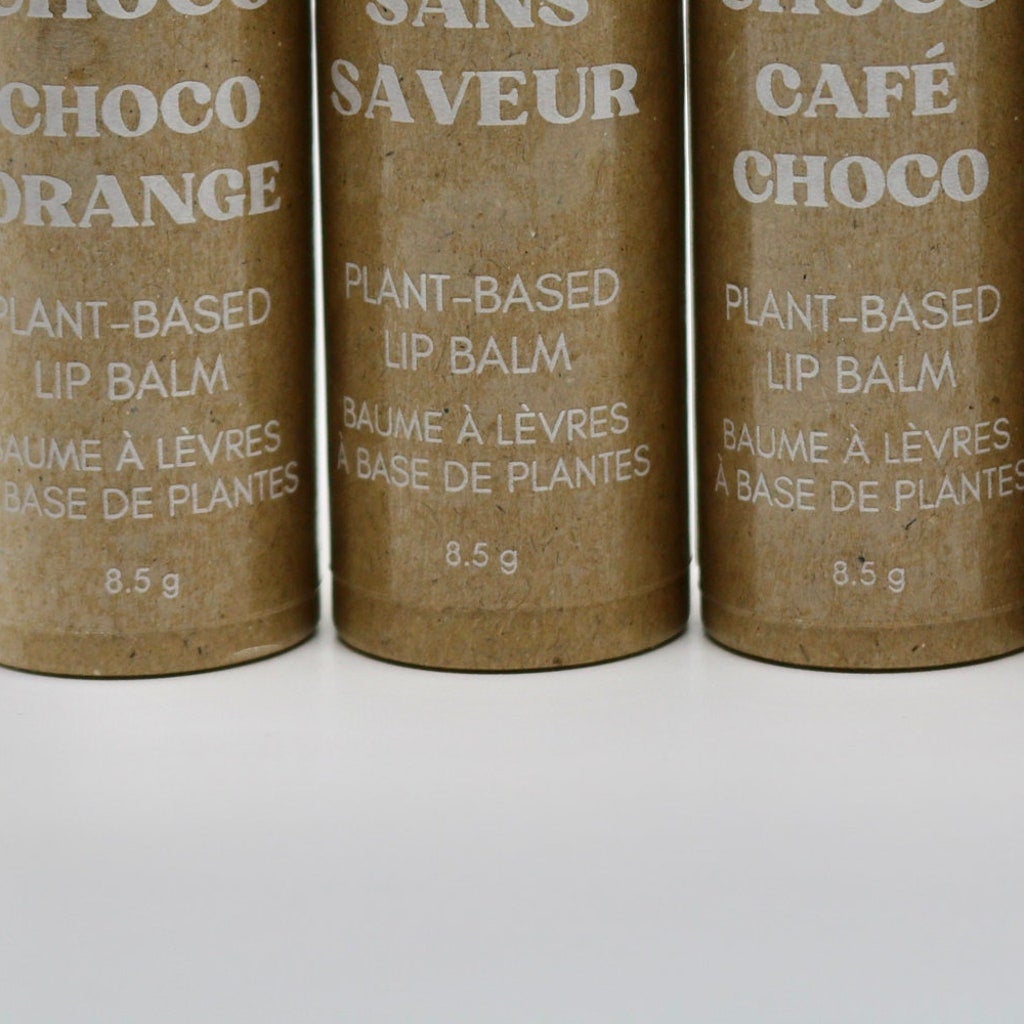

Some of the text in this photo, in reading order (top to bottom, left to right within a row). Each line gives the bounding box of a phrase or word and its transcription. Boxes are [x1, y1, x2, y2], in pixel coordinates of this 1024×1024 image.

[331, 59, 640, 125] SAVEUR
[755, 42, 958, 118] CAFÉ
[0, 75, 261, 137] CHOCO
[733, 149, 990, 209] CHOCO
[345, 262, 620, 314] PLANT-BASED
[725, 283, 1001, 333] PLANT-BASED
[34, 354, 229, 401] LIP BALM
[385, 329, 572, 375] LIP BALM
[766, 350, 957, 394] LIP BALM
[0, 420, 281, 472] AUME À LÈVRES
[343, 396, 629, 446] BAUME À LÈVRES
[723, 417, 1010, 465] BAUME À LÈVRES
[336, 432, 651, 494] À BASE DE PLANTES
[715, 454, 730, 496] À
[737, 469, 816, 511] BASE
[831, 480, 879, 513] DE
[4, 461, 299, 520] BASE DE PLANTES
[104, 567, 180, 599] 8.5 g
[446, 541, 518, 575] 8.5 g
[832, 560, 905, 593] 8.5 g
